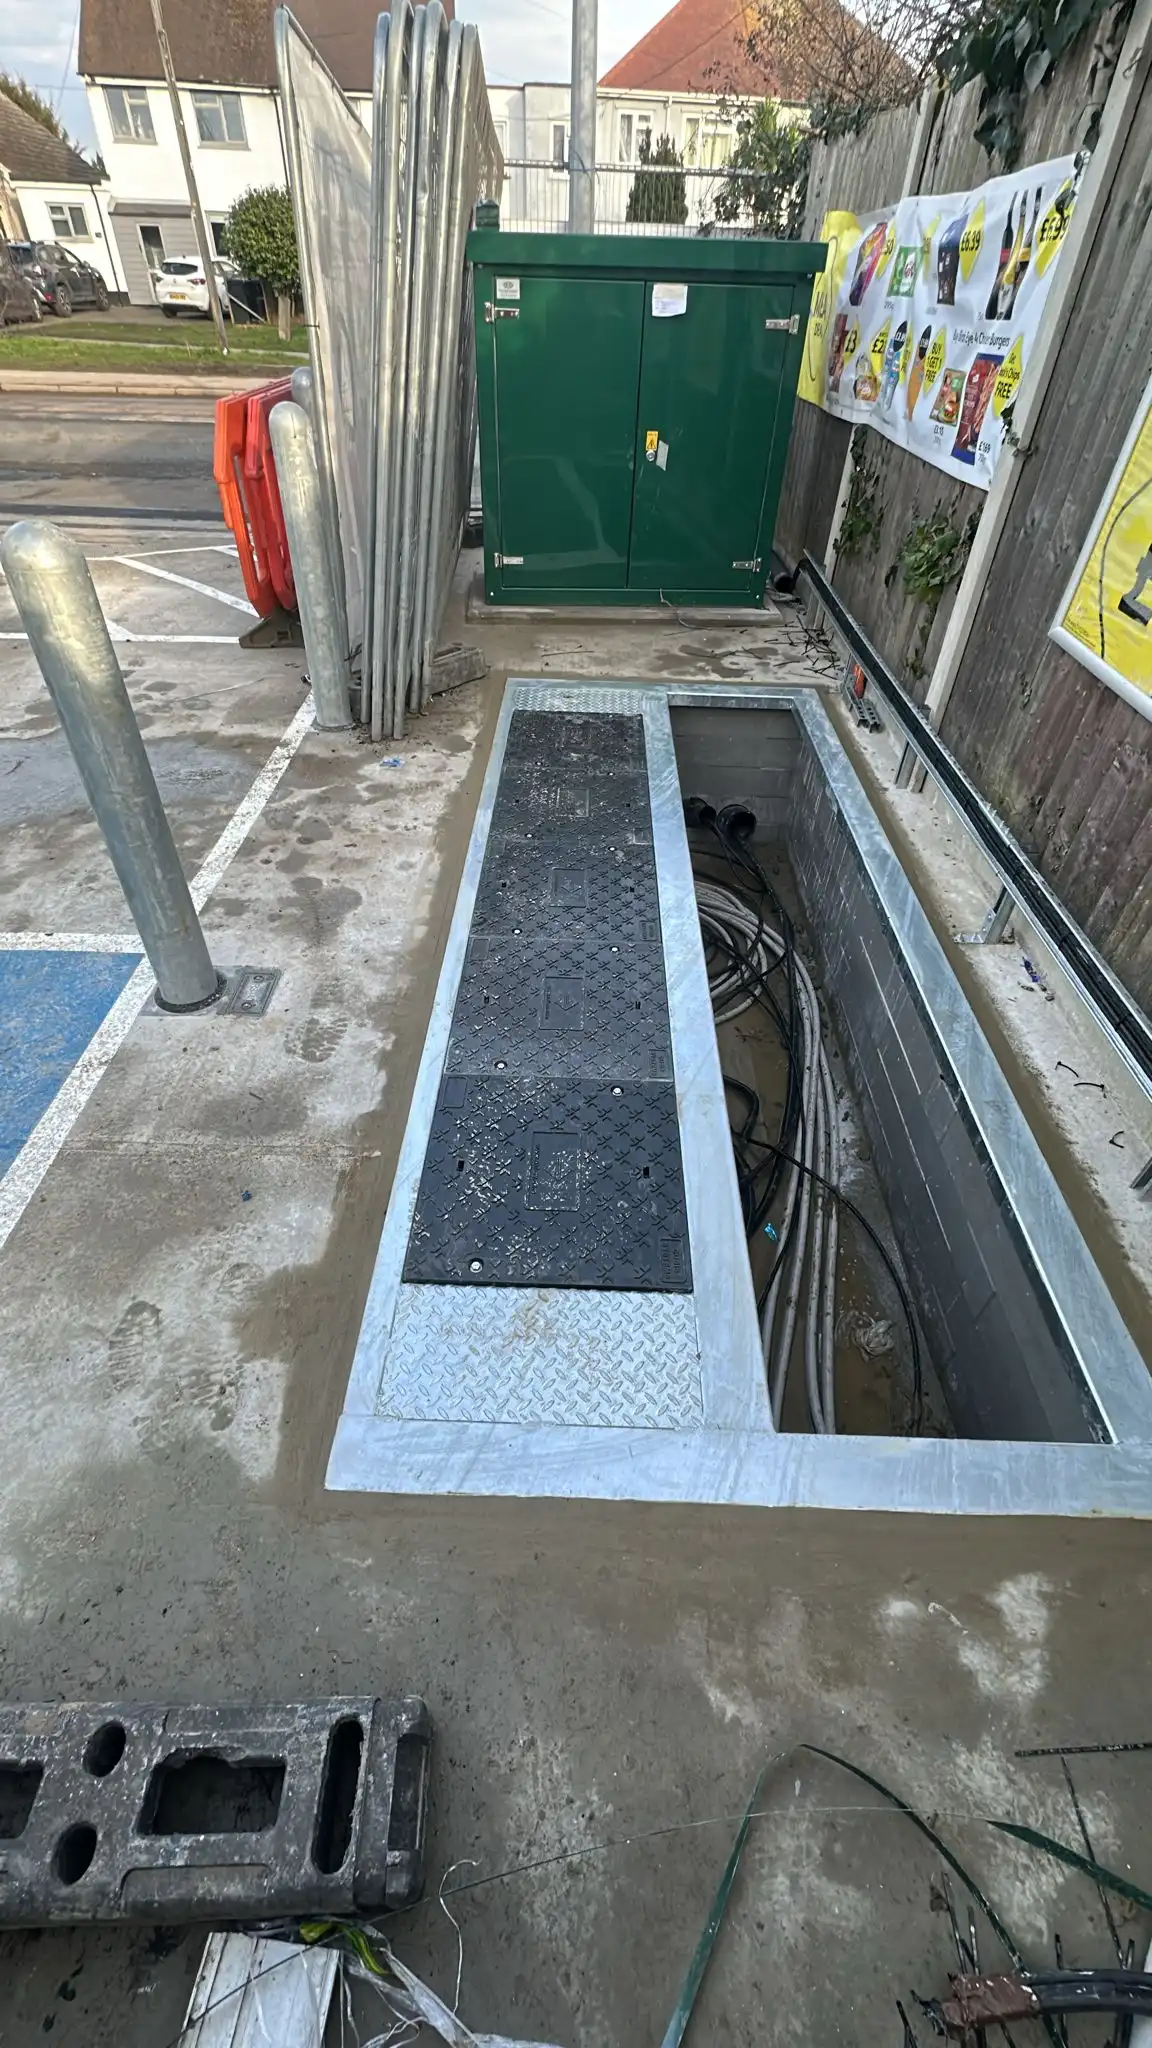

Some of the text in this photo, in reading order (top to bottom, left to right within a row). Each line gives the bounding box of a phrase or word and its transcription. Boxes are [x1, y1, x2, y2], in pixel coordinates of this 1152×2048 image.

[960, 230, 981, 251] £6.39
[932, 342, 942, 354] BUY
[989, 333, 1011, 349] Burgers
[925, 370, 937, 383] FREE
[995, 381, 1012, 399] FREE
